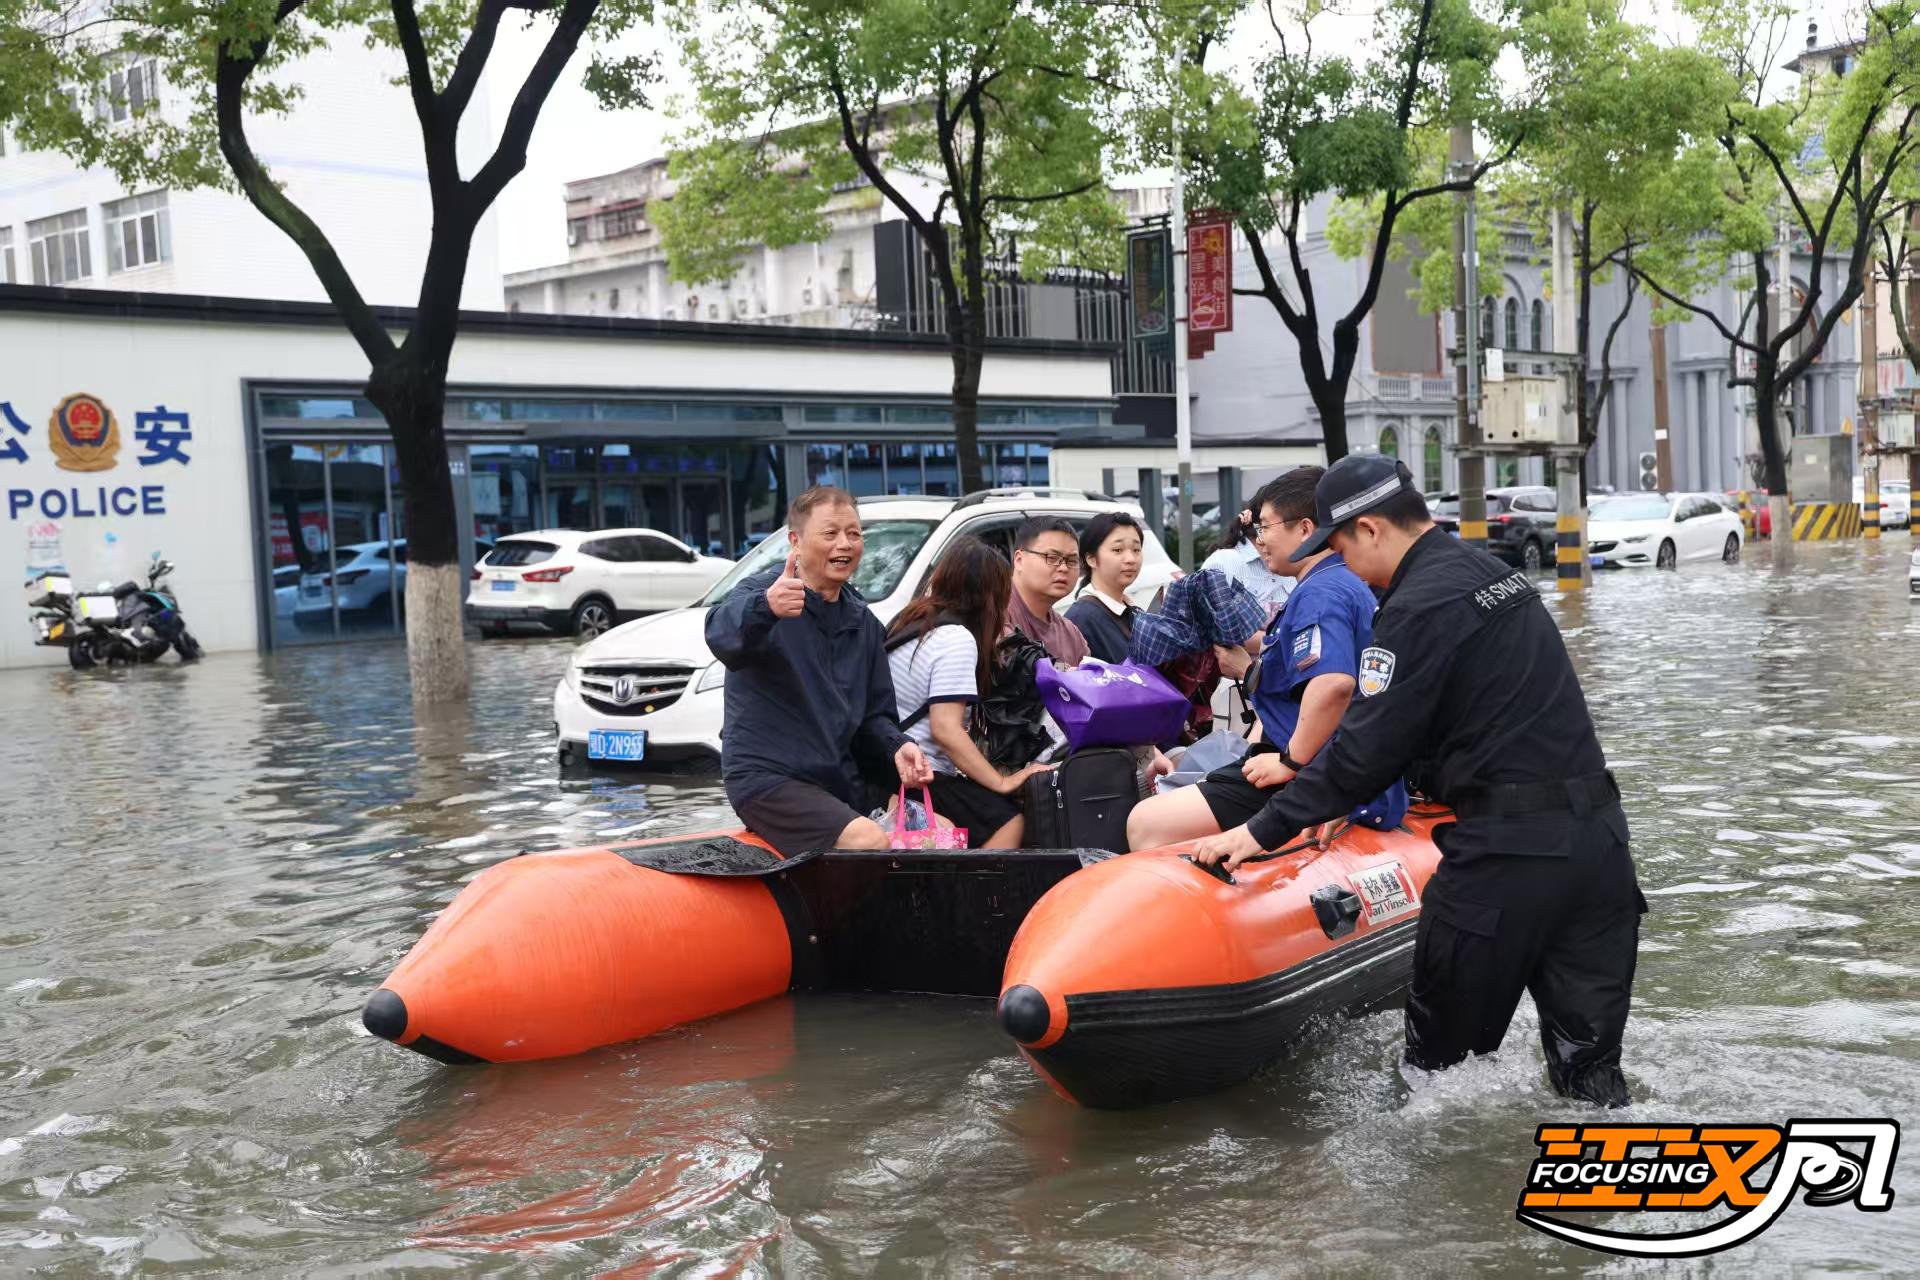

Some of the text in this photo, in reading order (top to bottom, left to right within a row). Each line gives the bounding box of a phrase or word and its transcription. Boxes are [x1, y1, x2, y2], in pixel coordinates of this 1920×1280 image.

[134, 405, 192, 466] 安
[8, 486, 166, 519] POLICE
[1474, 589, 1497, 610] 特
[1489, 572, 1527, 600] SWAT
